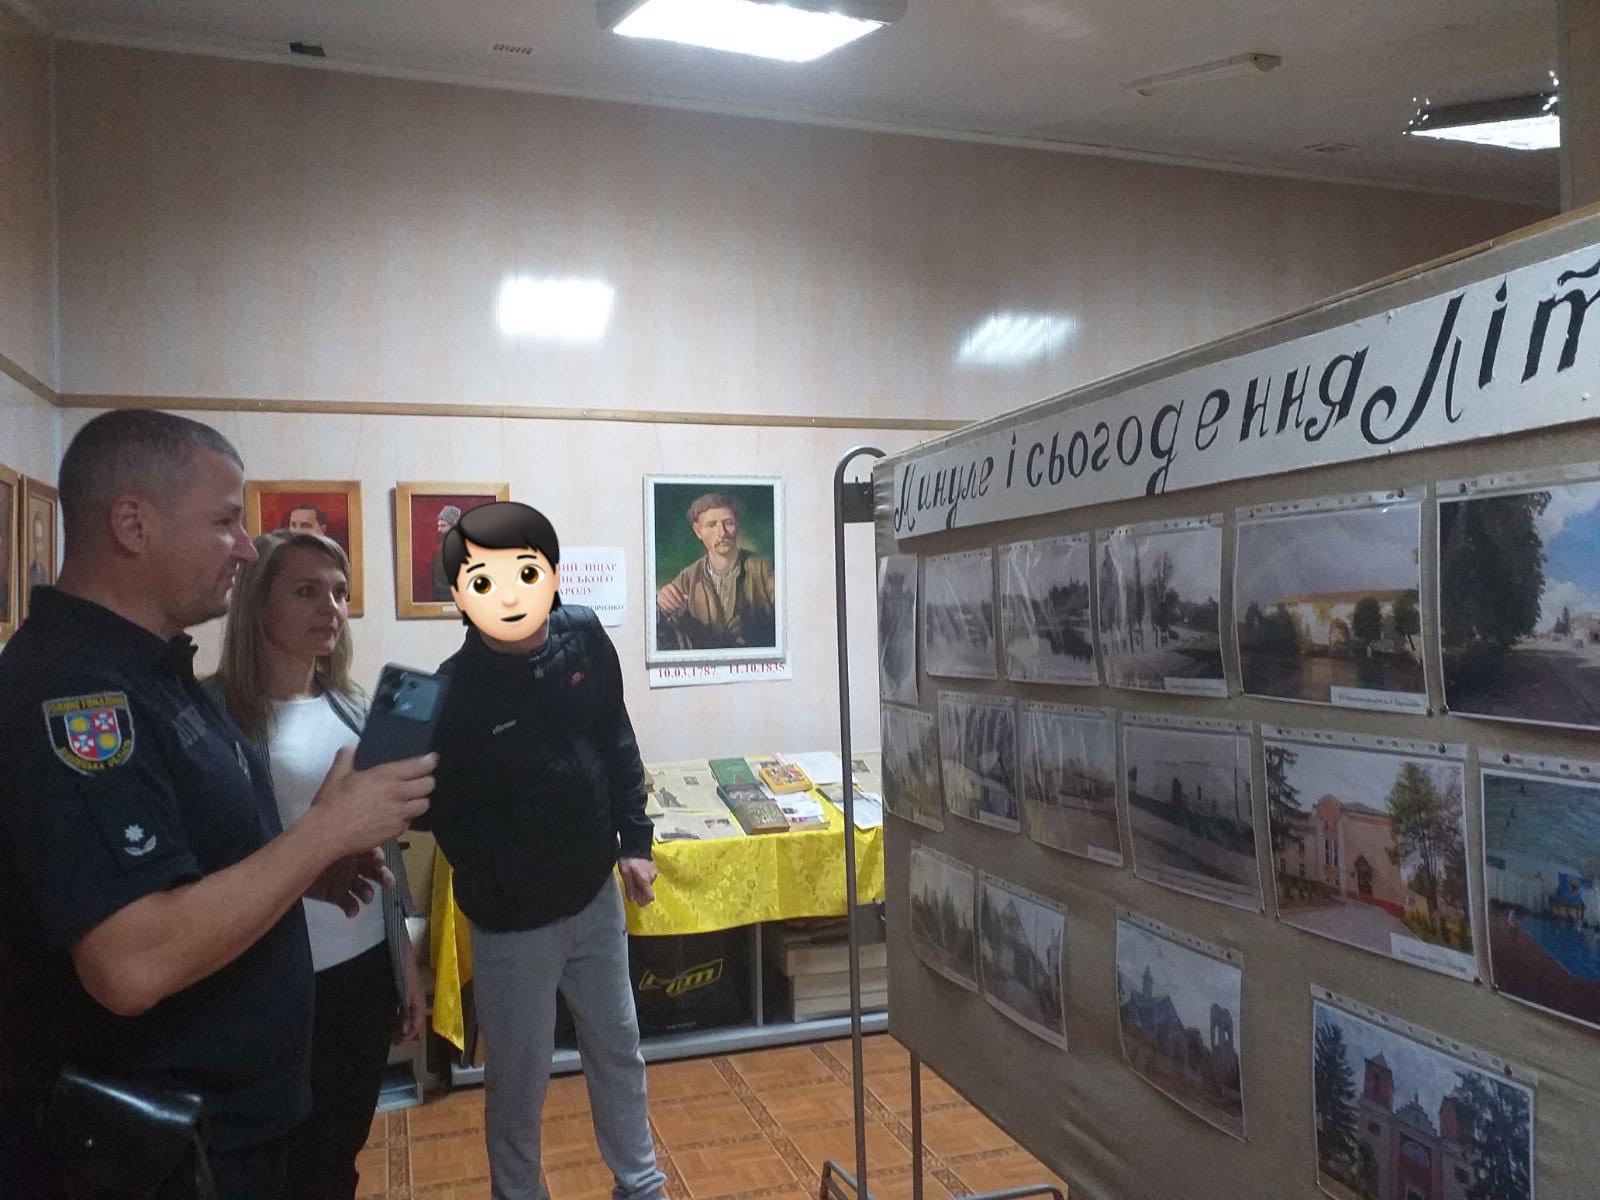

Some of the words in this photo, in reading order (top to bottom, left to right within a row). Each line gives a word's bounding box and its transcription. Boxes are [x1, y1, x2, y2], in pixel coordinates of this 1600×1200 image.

[893, 456, 994, 532] Минуле
[1006, 430, 1017, 489] і
[1026, 345, 1370, 496] сьогодення
[560, 575, 614, 584] НСЬКОГО
